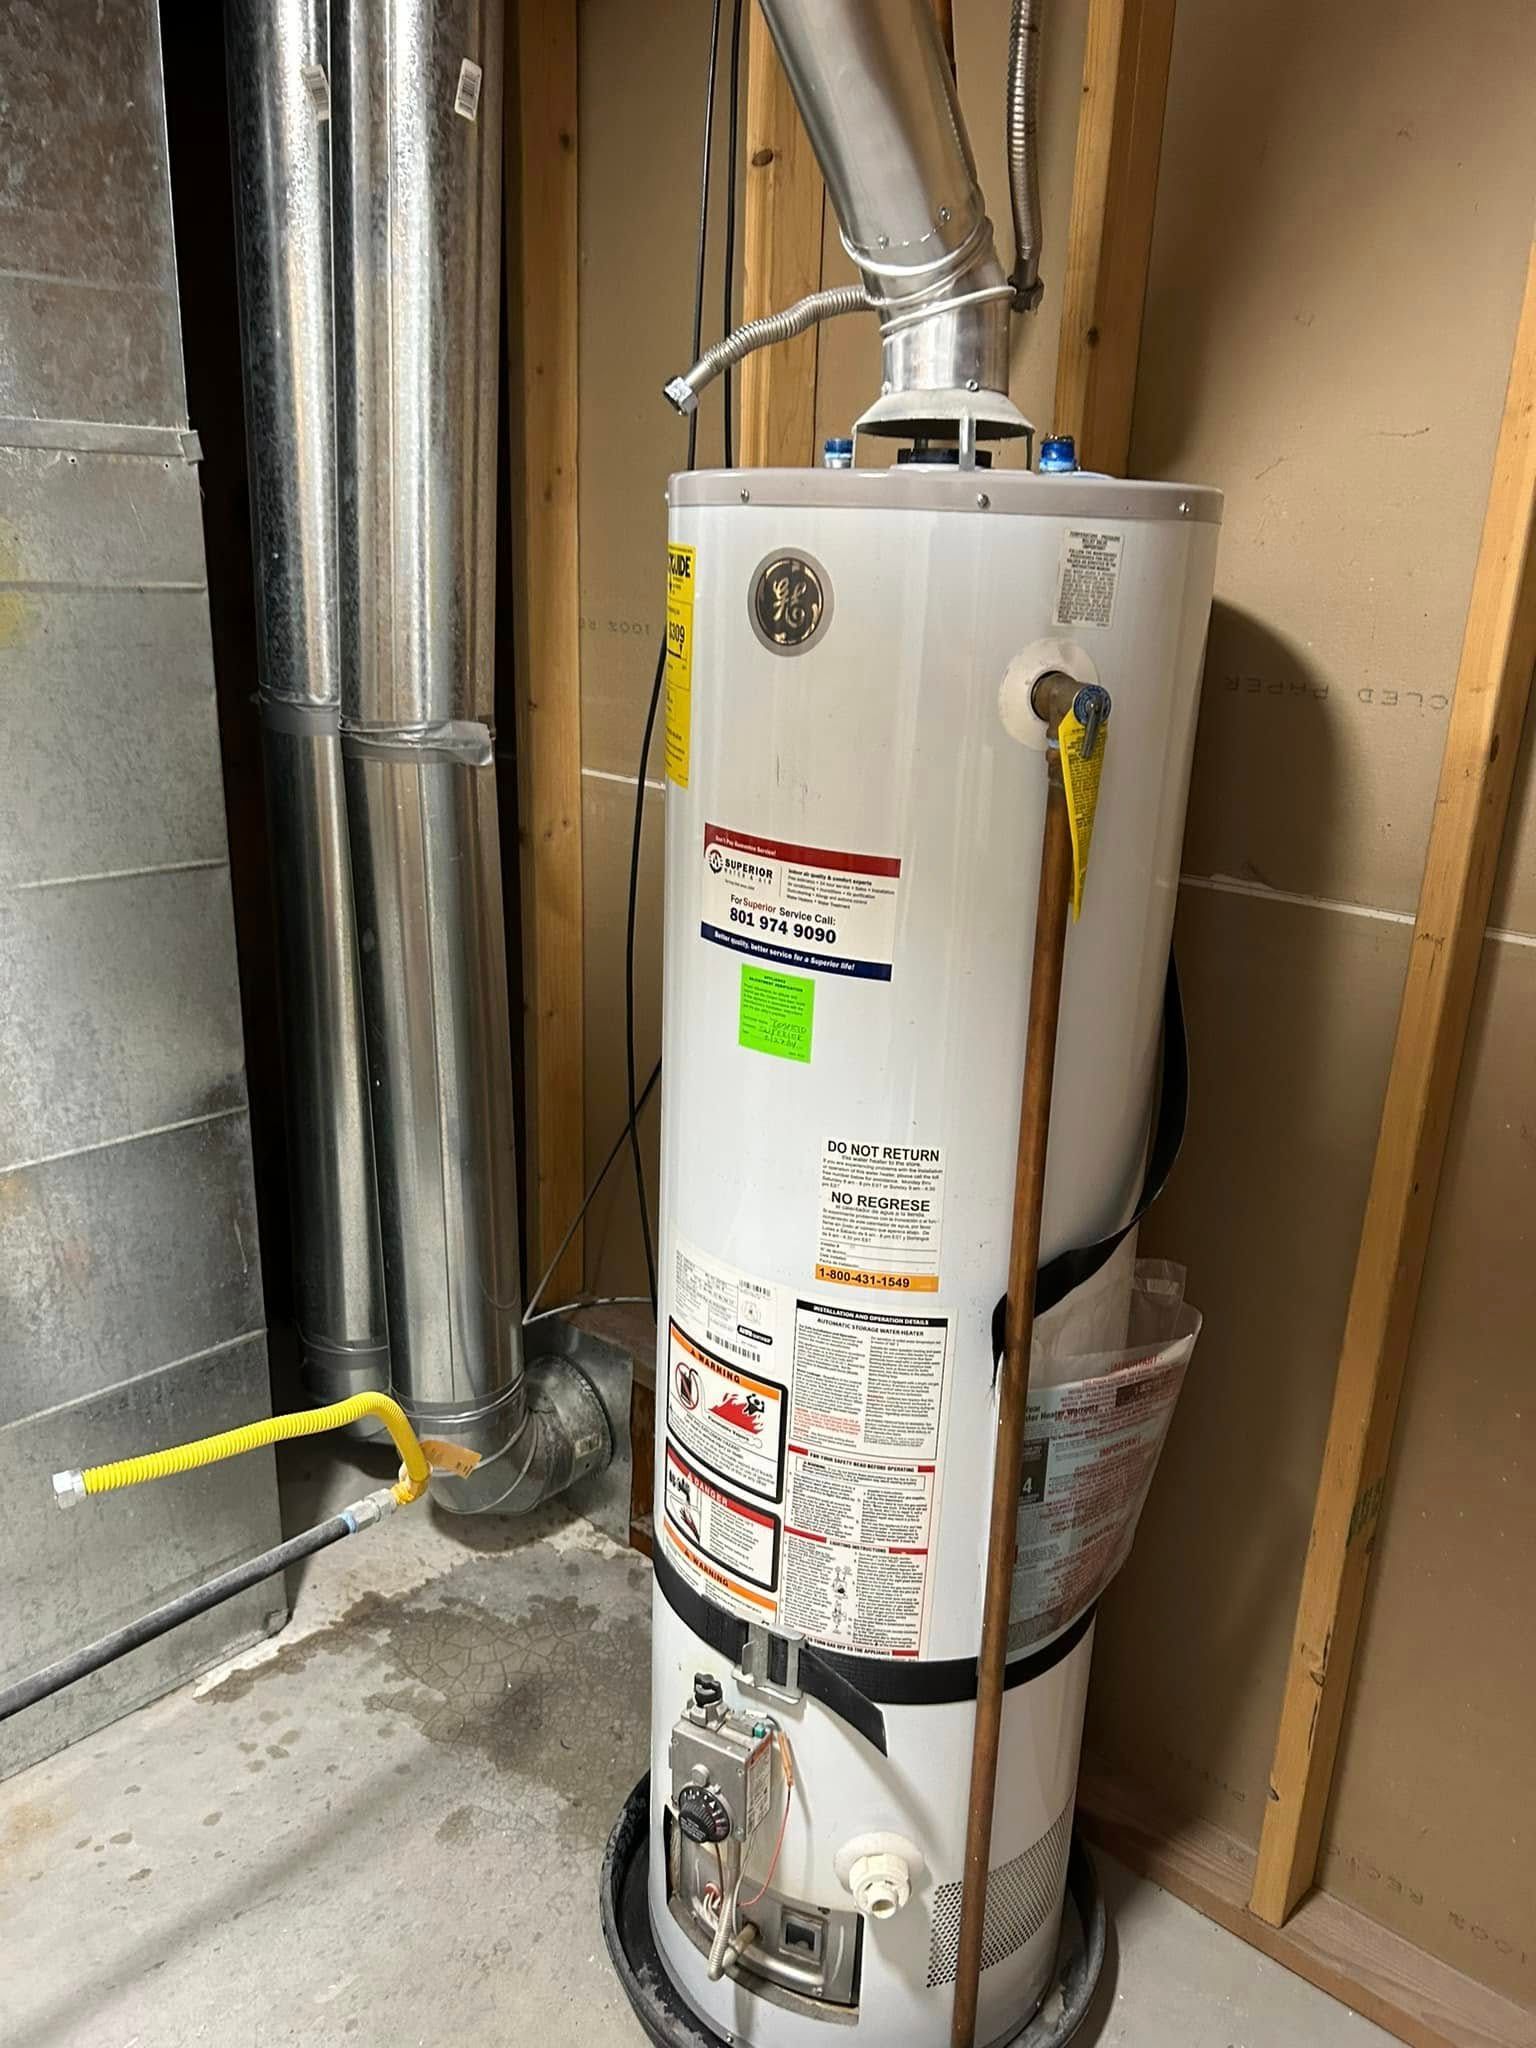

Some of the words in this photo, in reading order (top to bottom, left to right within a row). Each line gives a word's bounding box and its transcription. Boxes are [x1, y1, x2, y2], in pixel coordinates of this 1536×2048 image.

[1357, 686, 1449, 711] CLED
[725, 858, 773, 879] SUPERIOR
[789, 868, 803, 876] Indoor
[811, 872, 826, 881] quality
[833, 876, 852, 884] comfort
[853, 879, 872, 887] experts
[730, 894, 742, 905] For
[743, 897, 777, 914] Superior
[780, 907, 812, 922] Service
[814, 914, 837, 926] Call:
[730, 907, 755, 927] 801
[759, 916, 788, 935] 974
[793, 923, 836, 944] 9090
[714, 930, 730, 942] Better
[751, 943, 769, 953] better
[769, 948, 792, 960] service
[793, 953, 803, 962] for
[811, 957, 839, 969] Superior
[841, 962, 856, 971] life!
[828, 1140, 847, 1154] DO
[851, 1144, 879, 1158] NOT
[883, 1147, 940, 1162] RETURN
[831, 1191, 853, 1205] NO
[857, 1195, 930, 1212] REGRESE
[819, 1267, 910, 1288] 1-800-431-1549
[813, 1305, 854, 1318] INSTALLATION
[855, 1313, 868, 1321] AND
[869, 1315, 904, 1324] OPERATION
[905, 1318, 929, 1326] DETAILS
[817, 1317, 850, 1329] AUTOMATIC
[852, 1324, 879, 1334] STORAGE
[697, 1353, 741, 1384] WARNING
[820, 1455, 833, 1463] YOUR
[834, 1458, 852, 1466] SAFETY
[867, 1463, 886, 1471] BEFORE
[887, 1465, 915, 1473] OPERATING
[694, 1478, 728, 1507] DANGER
[1023, 1477, 1032, 1494] 4
[829, 1540, 851, 1549] LIGHTING
[852, 1544, 887, 1553] INSTRUCTIONS
[693, 1556, 729, 1588] WARNING
[814, 1638, 826, 1646] TURN
[827, 1641, 836, 1649] GAS
[864, 1648, 891, 1656] APPLIANCE
